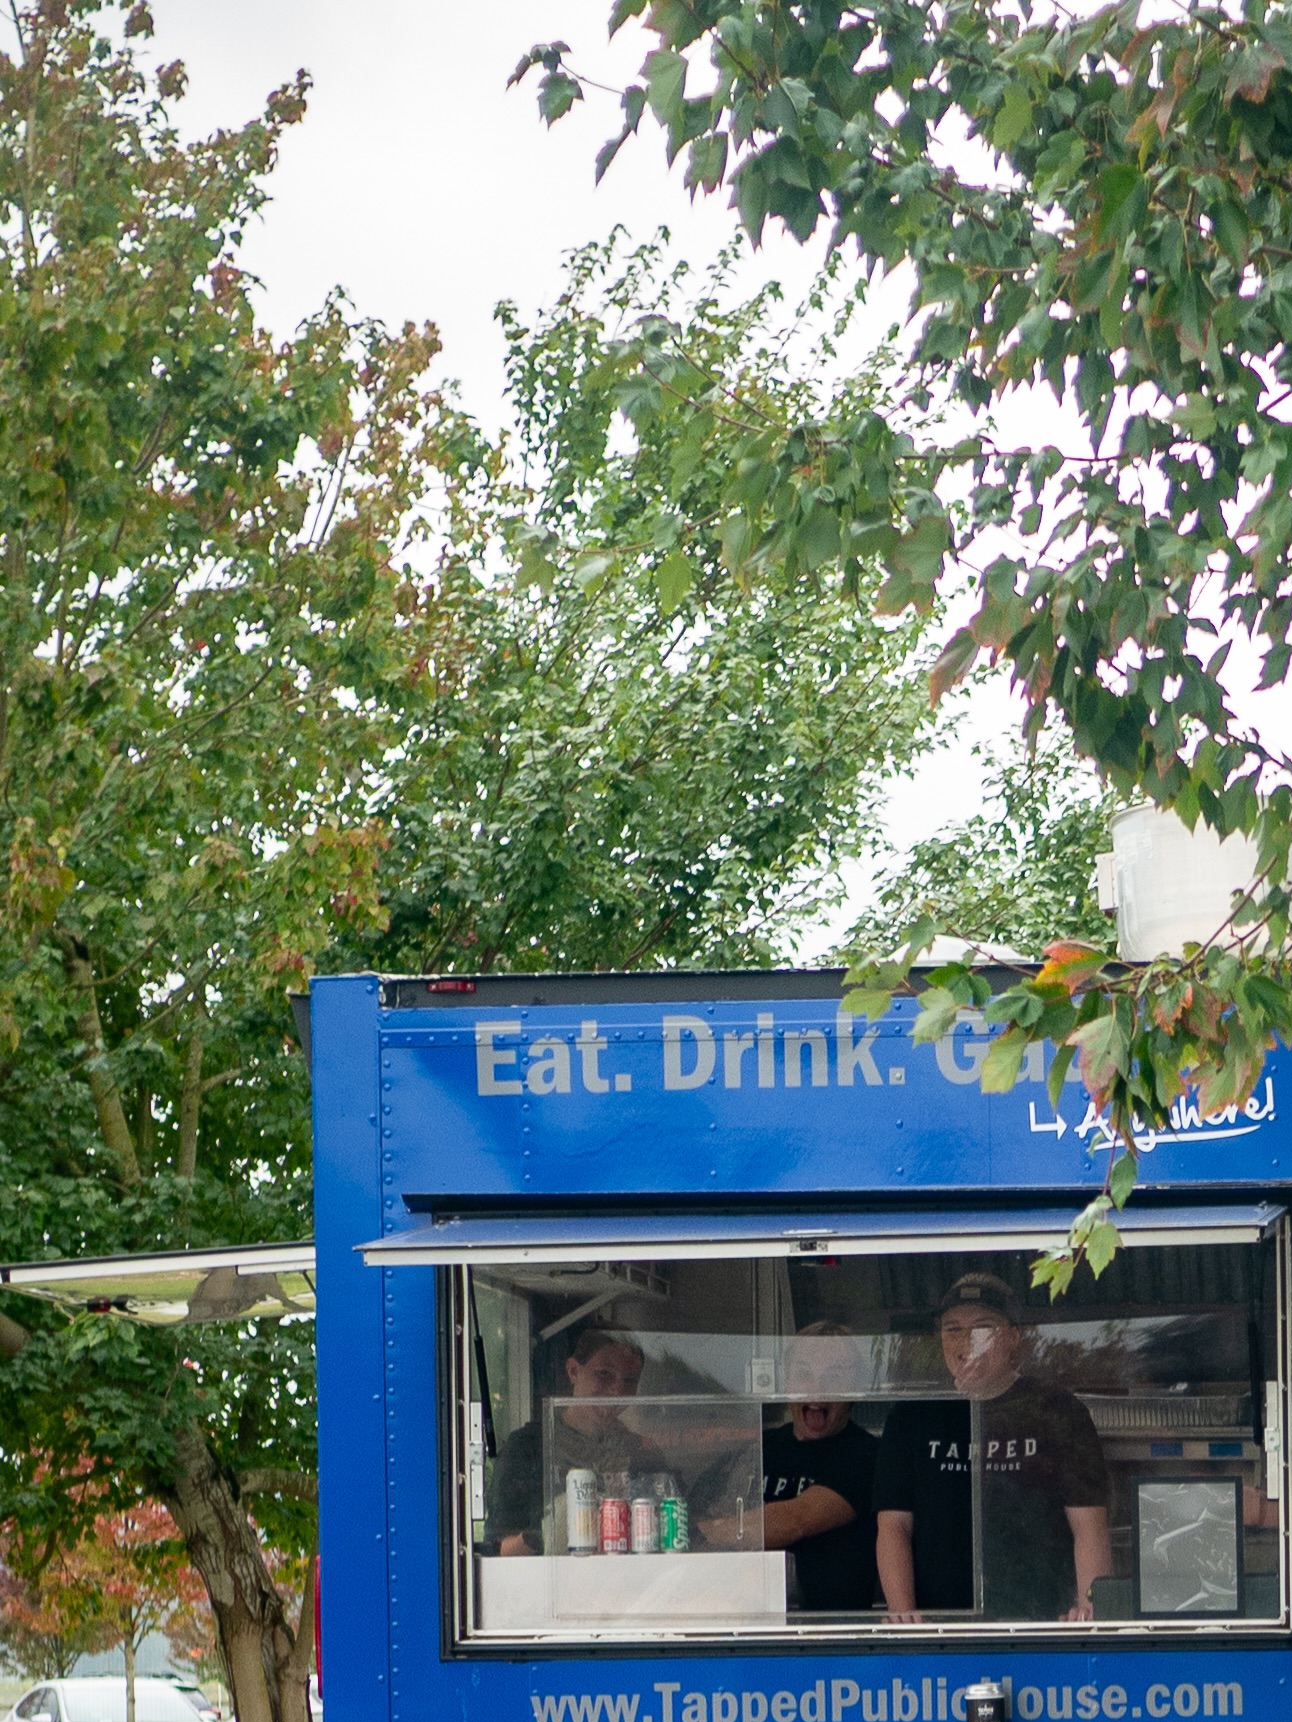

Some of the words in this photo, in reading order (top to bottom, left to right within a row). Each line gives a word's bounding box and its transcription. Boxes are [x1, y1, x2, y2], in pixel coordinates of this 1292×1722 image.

[475, 1020, 632, 1097] Eat.
[664, 1011, 908, 1094] Drink.
[1073, 1076, 1276, 1153] Ayhere!
[928, 1438, 1038, 1461] TAPPED
[673, 1498, 690, 1550] Sprite
